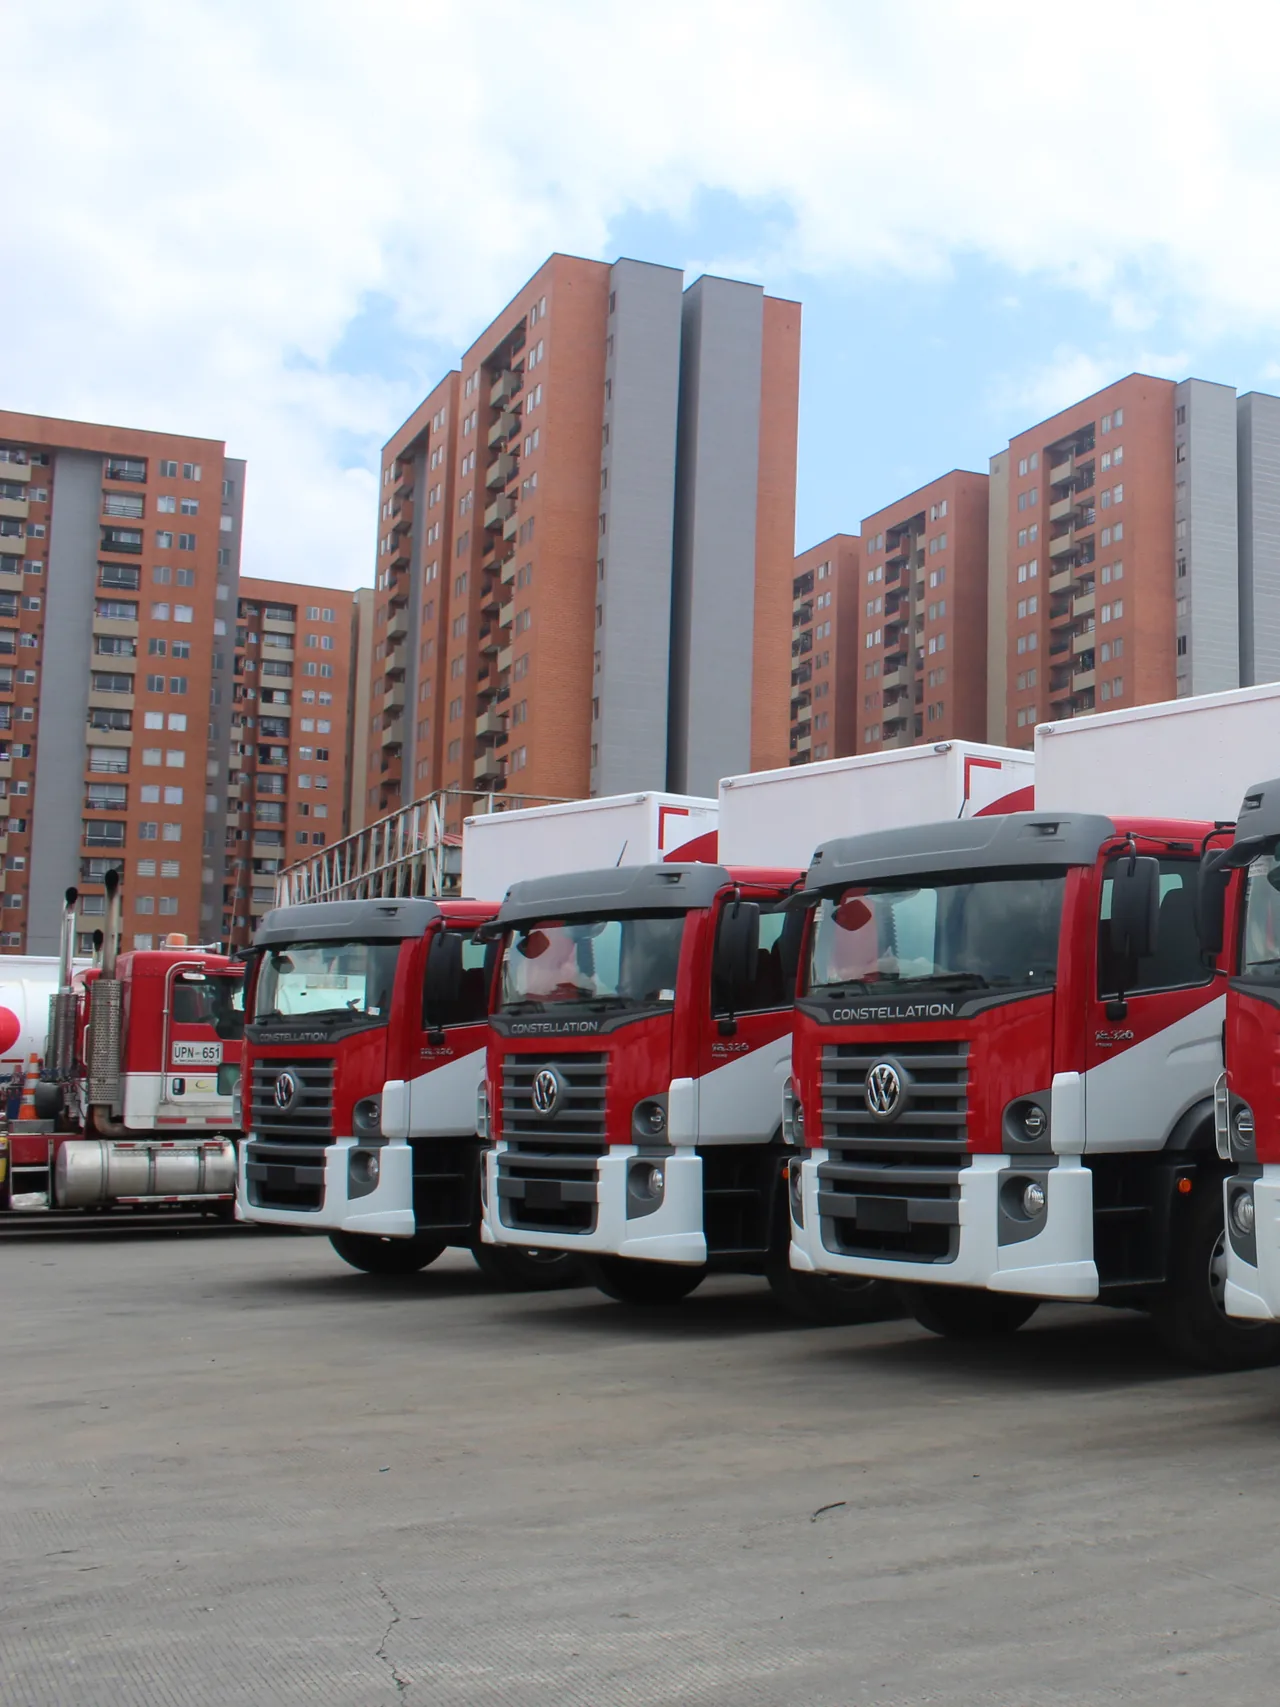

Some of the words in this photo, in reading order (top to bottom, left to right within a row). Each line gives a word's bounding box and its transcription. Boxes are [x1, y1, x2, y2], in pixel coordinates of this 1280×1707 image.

[832, 1003, 954, 1020] CONSTELLATION
[511, 1021, 598, 1034] CONSTELLATION
[259, 1032, 328, 1042] CONSTELLATION
